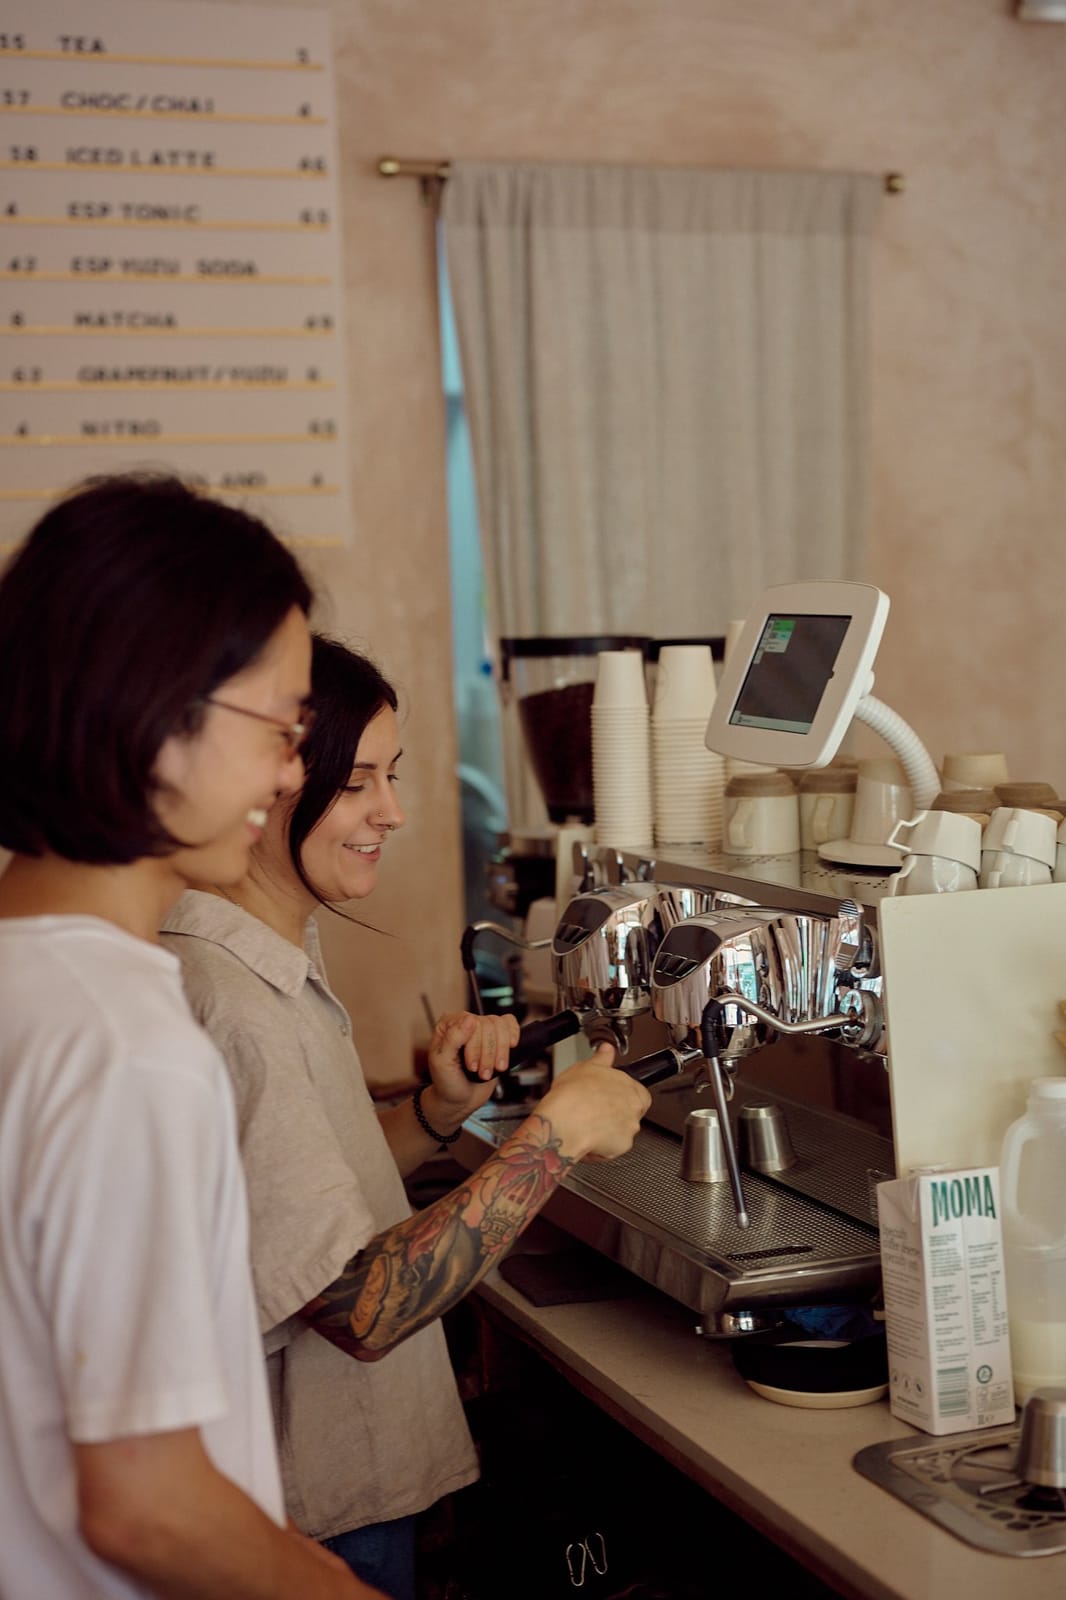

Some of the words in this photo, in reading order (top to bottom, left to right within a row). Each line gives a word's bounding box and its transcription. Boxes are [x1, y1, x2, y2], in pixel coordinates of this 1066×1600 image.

[58, 36, 104, 53] TEA
[65, 147, 123, 165] ICED
[131, 151, 215, 167] LATTE
[68, 202, 112, 218] ESP
[120, 202, 198, 221] TONIC
[70, 257, 113, 273] ESP
[118, 258, 180, 275] YUZU
[196, 259, 258, 276] SODA
[74, 311, 176, 328] MATCHA
[81, 420, 160, 435] NITRO
[931, 1175, 996, 1227] MOMA
